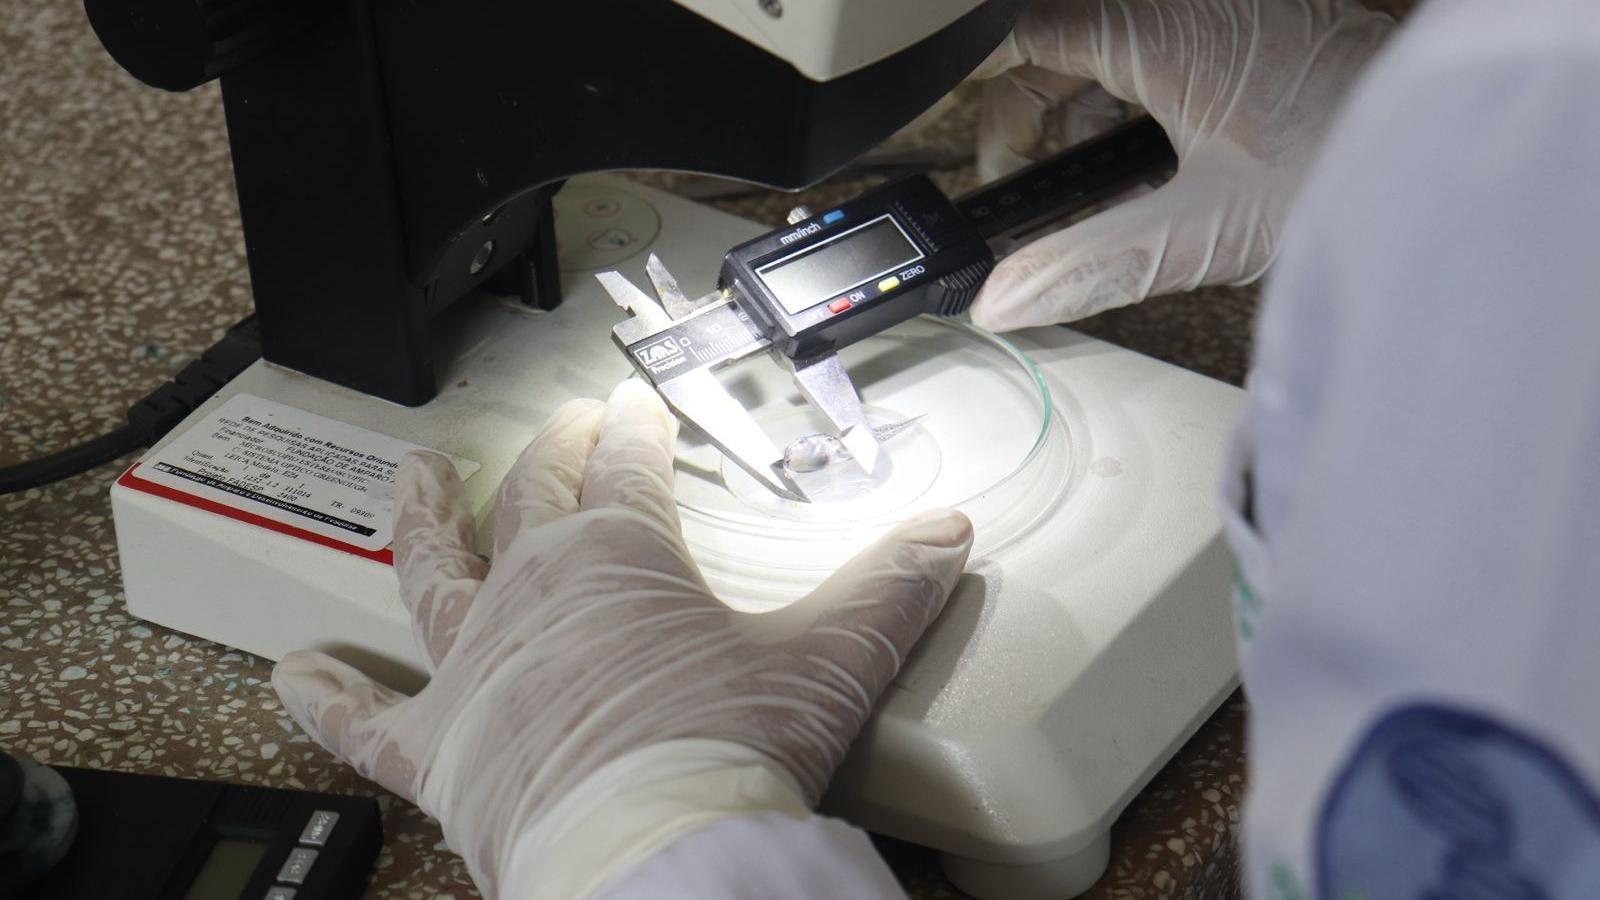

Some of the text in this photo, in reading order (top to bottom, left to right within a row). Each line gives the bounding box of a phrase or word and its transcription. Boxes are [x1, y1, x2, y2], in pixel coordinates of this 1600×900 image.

[780, 222, 822, 245] mm/inch
[899, 265, 926, 281] ZERO
[850, 291, 866, 303] ON
[650, 356, 688, 375] Precision
[241, 416, 262, 426] Bem
[263, 423, 302, 438] Adquirido
[304, 437, 323, 445] com
[323, 441, 364, 457] Recursos
[258, 430, 308, 448] PESQUISAS
[308, 446, 358, 464] APLICADAS
[359, 461, 383, 472] PARA
[285, 446, 334, 464] FUNDAÇÃO
[334, 461, 349, 469] DE
[349, 466, 389, 481] AMPARO
